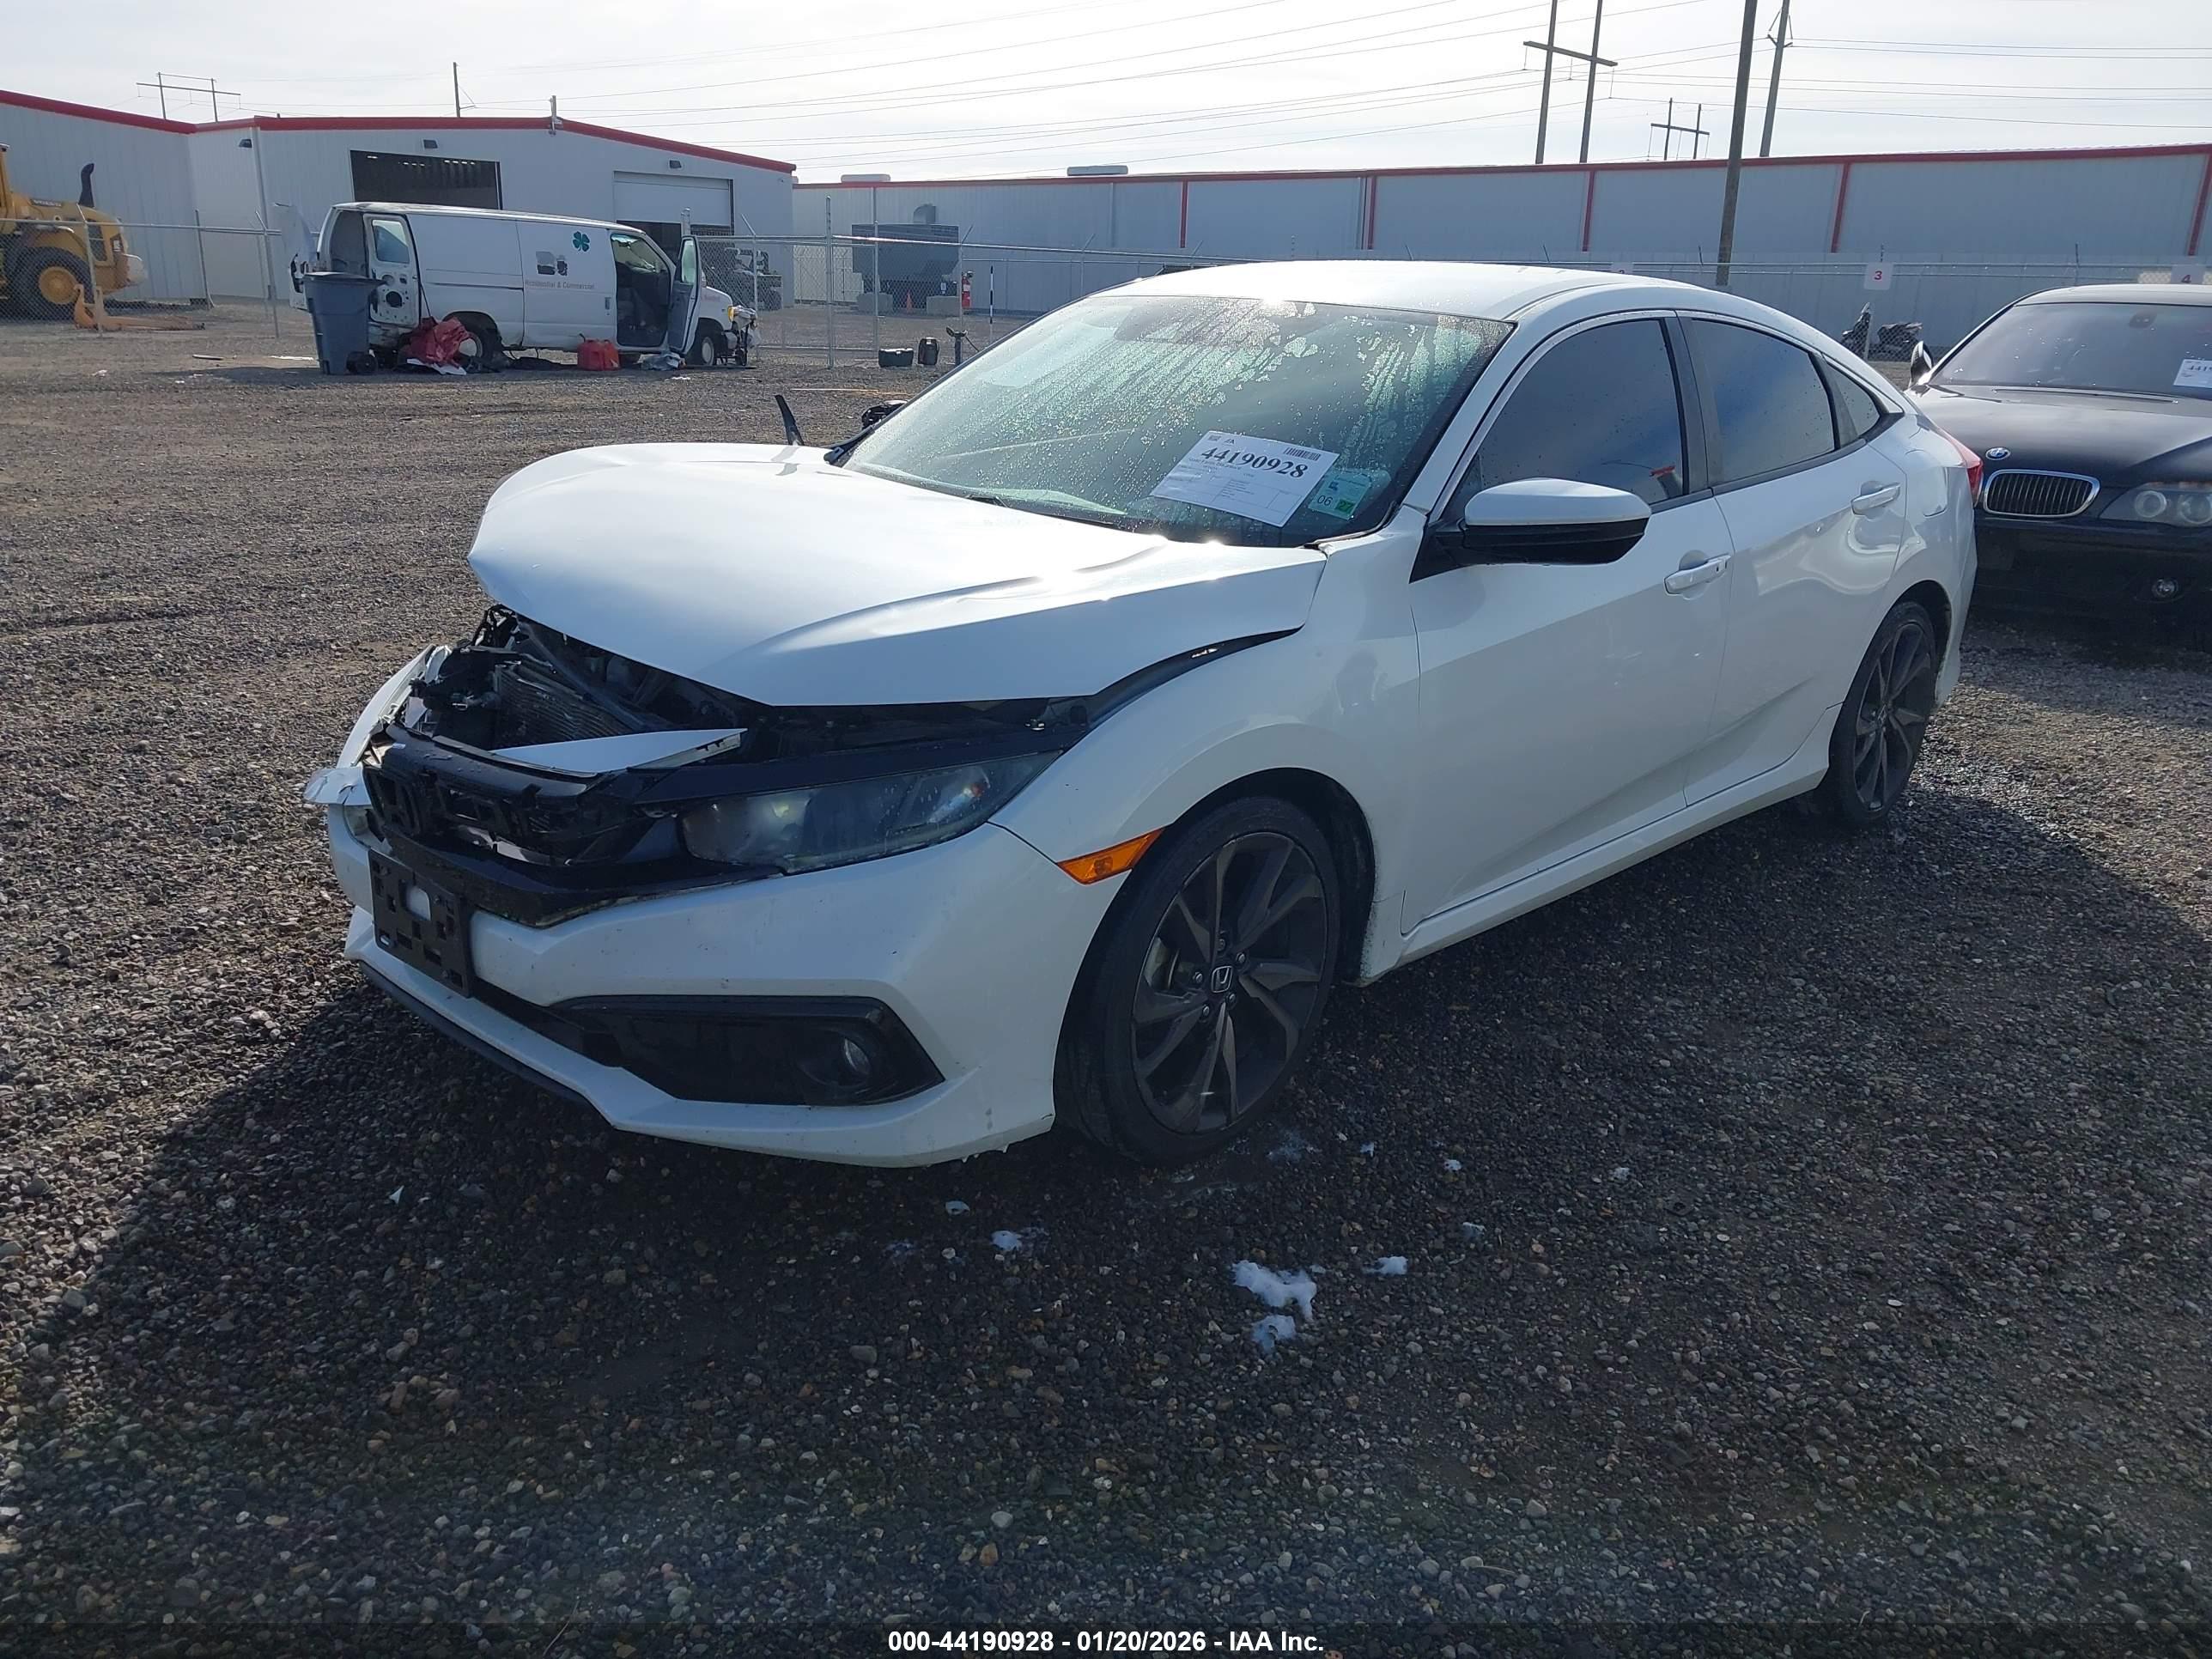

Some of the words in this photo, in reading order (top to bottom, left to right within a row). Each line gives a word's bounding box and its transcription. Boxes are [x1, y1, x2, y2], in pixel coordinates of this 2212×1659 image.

[1874, 270, 1883, 281] 3
[1201, 447, 1309, 478] 44190928
[1317, 495, 1333, 507] 06
[1340, 501, 1355, 513] 27
